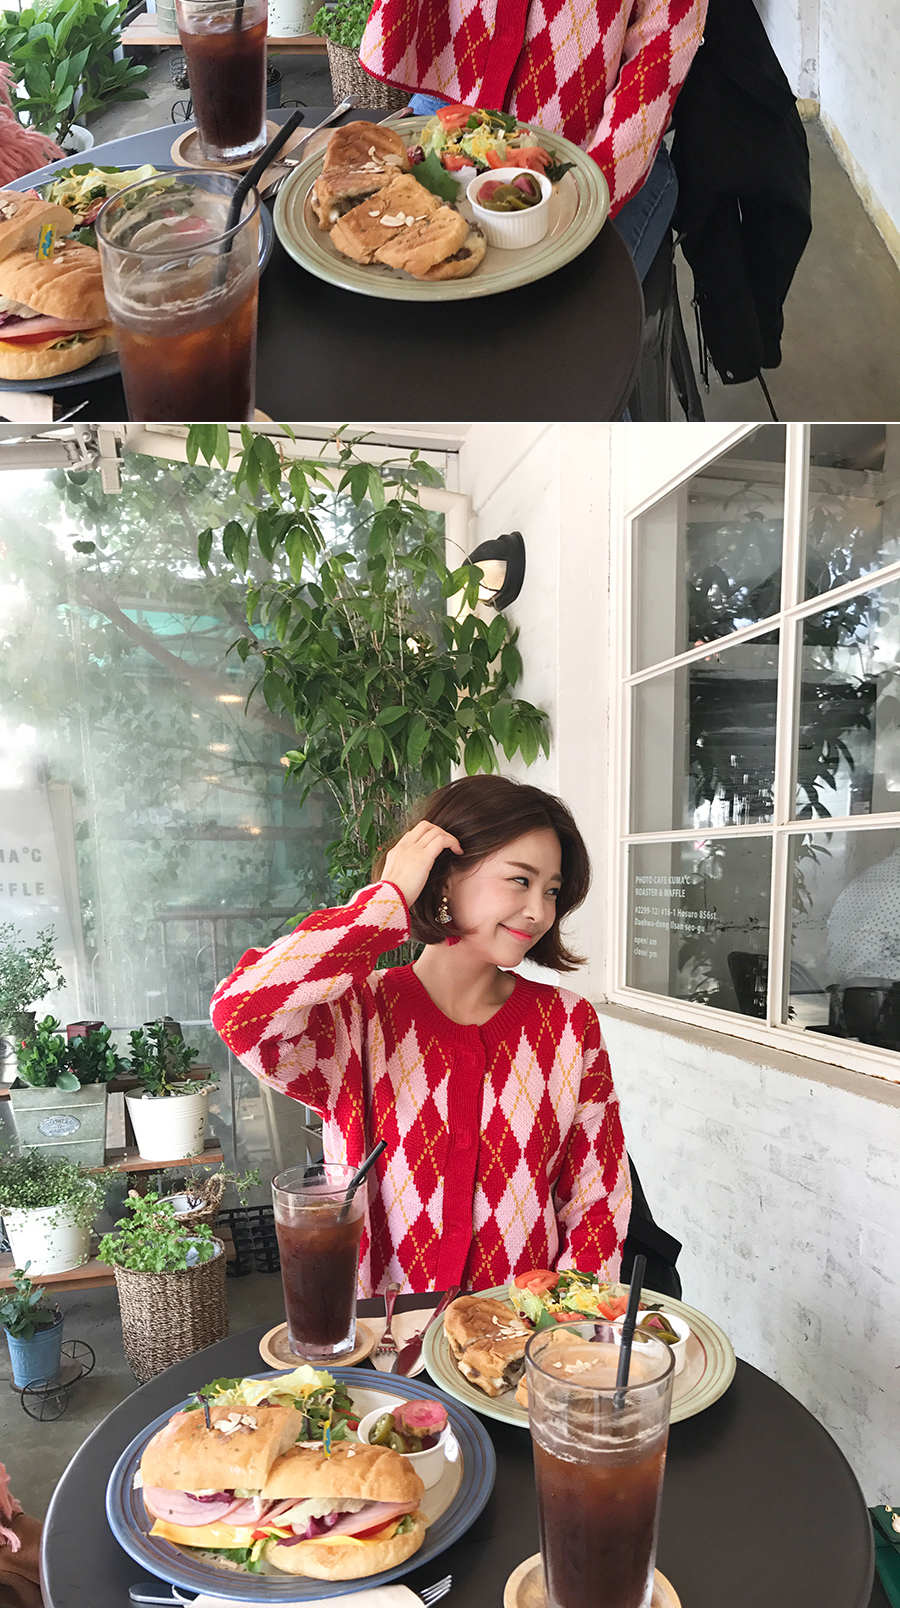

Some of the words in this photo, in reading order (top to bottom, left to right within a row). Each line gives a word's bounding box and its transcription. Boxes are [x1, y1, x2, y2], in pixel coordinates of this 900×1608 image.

[635, 875, 653, 884] PHOTO
[653, 875, 668, 884] CAFE
[635, 887, 658, 897] ROASTER
[658, 887, 664, 897] &
[664, 888, 686, 898] WAFFLE
[677, 909, 699, 919] Hosuro
[699, 910, 717, 920] 856st
[684, 923, 705, 934] seo-gu
[649, 950, 658, 959] pm
